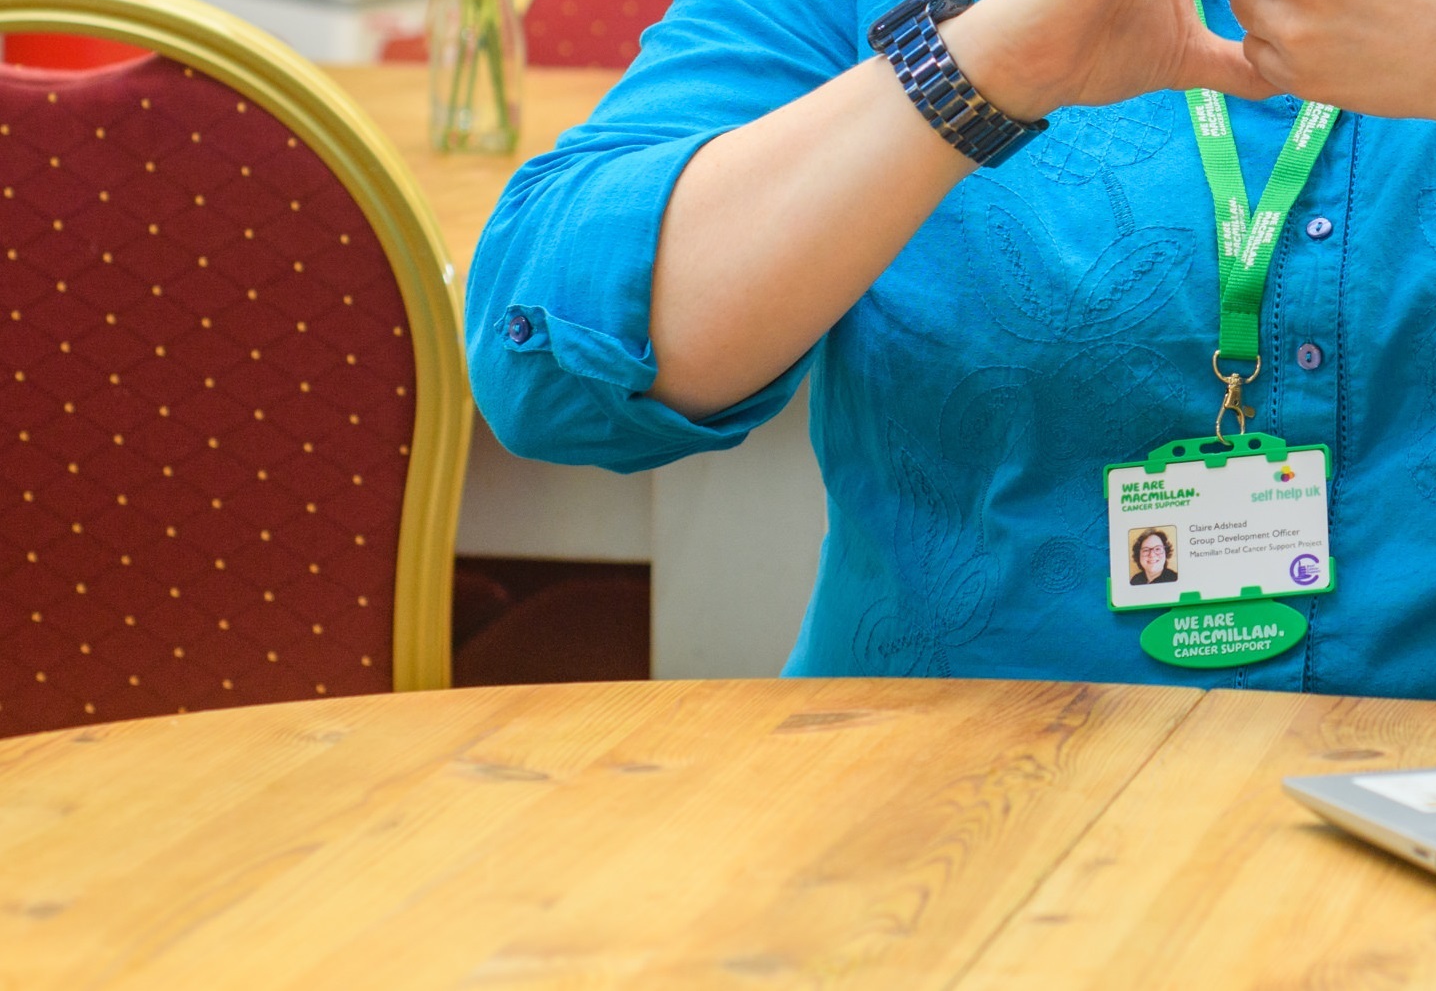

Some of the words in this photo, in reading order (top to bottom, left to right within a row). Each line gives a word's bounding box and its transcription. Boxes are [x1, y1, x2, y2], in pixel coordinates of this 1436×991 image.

[1295, 102, 1325, 150] ACMILLAN.
[1122, 482, 1140, 493] WE
[1142, 480, 1165, 491] ARE
[1251, 489, 1273, 502] self
[1276, 487, 1303, 501] help
[1305, 485, 1321, 497] uk
[1121, 488, 1200, 504] MACMILLAN.
[1121, 503, 1153, 512] CANCER
[1154, 499, 1191, 510] SUPPORT
[1189, 524, 1213, 533] Claire
[1214, 520, 1248, 530] Adshead
[1189, 537, 1215, 547] Group
[1217, 531, 1270, 543] Development
[1272, 529, 1301, 538] Officer
[1189, 548, 1223, 558] Macmillan
[1224, 546, 1241, 555] Deaf
[1242, 544, 1267, 553] Cancer
[1268, 541, 1296, 552] Support
[1297, 539, 1323, 550] Project
[1174, 616, 1200, 630] WE
[1203, 612, 1235, 628] ARE
[1172, 623, 1285, 646] MACMILLAN.
[1174, 645, 1219, 658] CANCER
[1220, 640, 1272, 655] SUPPORT
